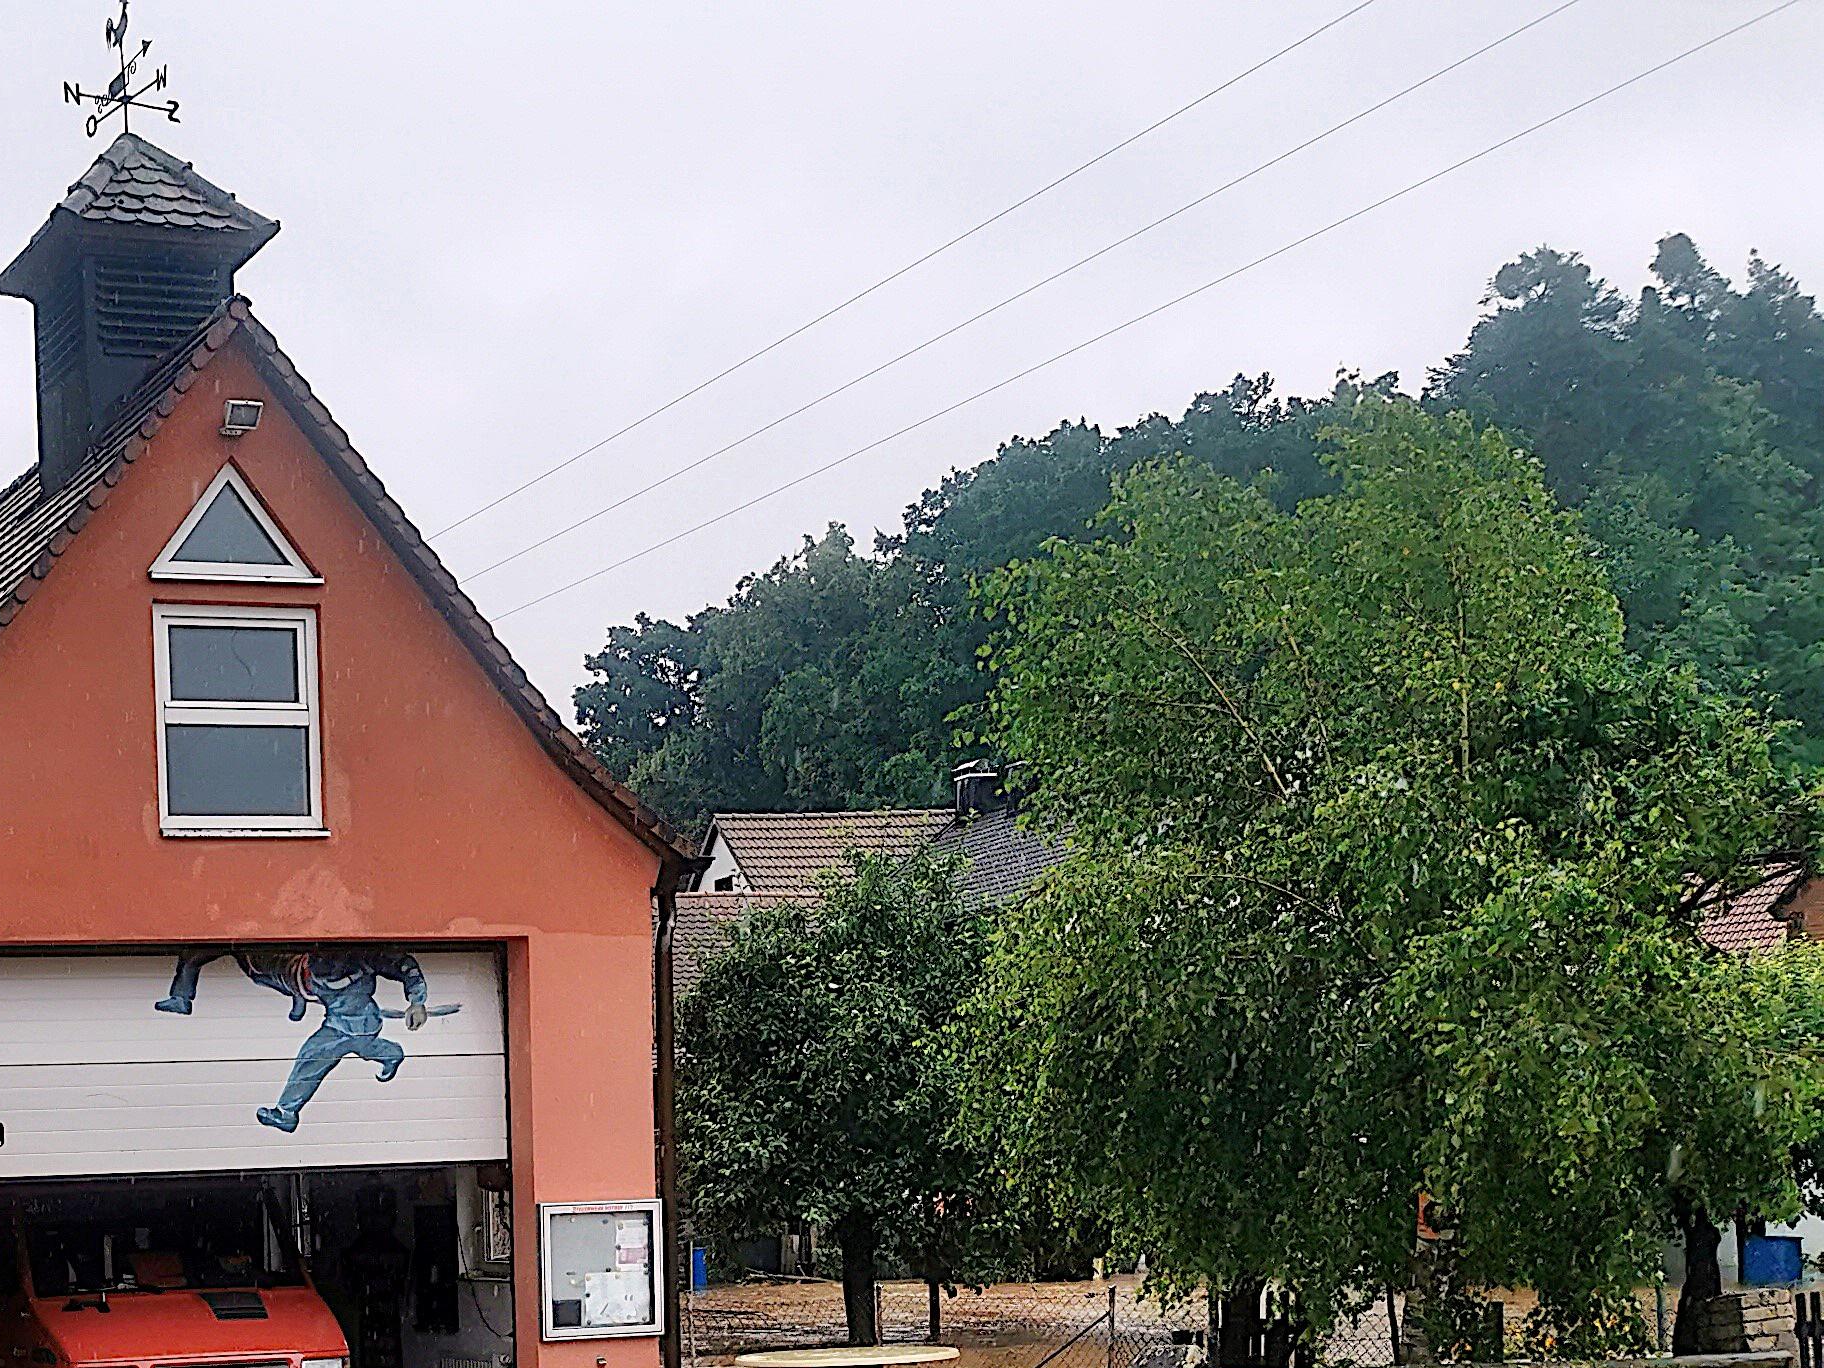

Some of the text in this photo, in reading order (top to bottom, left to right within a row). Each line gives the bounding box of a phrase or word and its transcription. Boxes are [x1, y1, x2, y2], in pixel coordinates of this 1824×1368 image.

[156, 63, 167, 92] W
[64, 81, 81, 106] N
[86, 114, 98, 138] O
